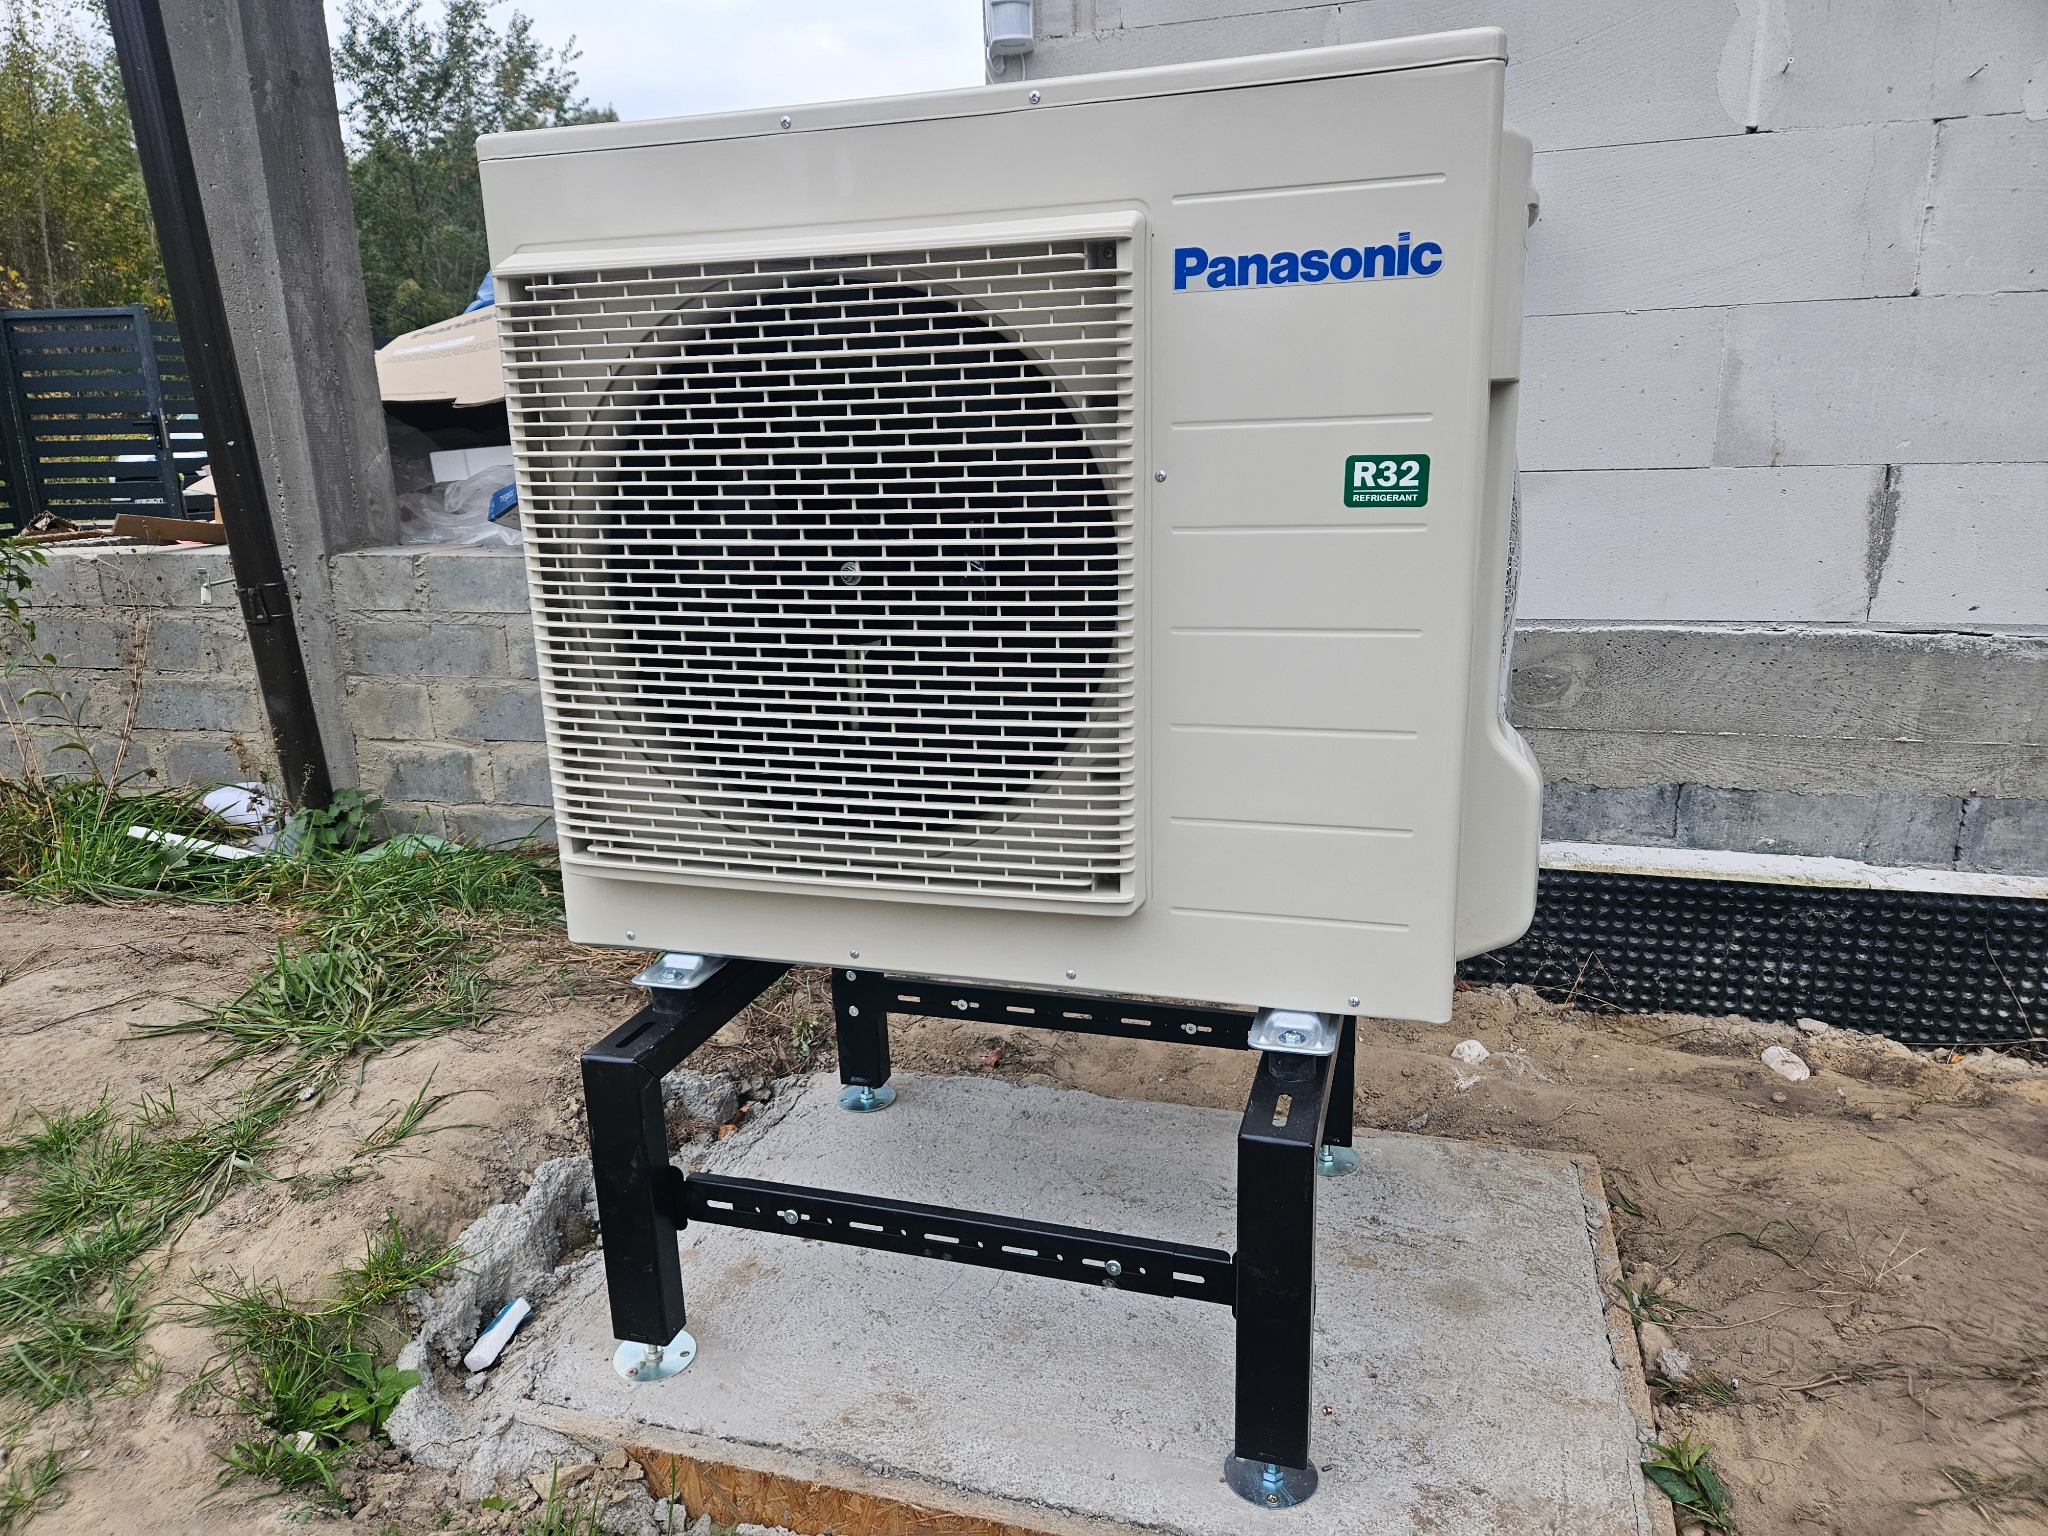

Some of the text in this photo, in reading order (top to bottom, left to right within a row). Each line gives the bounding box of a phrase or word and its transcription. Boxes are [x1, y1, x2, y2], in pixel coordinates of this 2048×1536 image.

[1174, 231, 1443, 290] Panasonic
[410, 313, 497, 339] Panas
[1353, 460, 1420, 487] R32
[1352, 494, 1418, 502] REFRIGERANT
